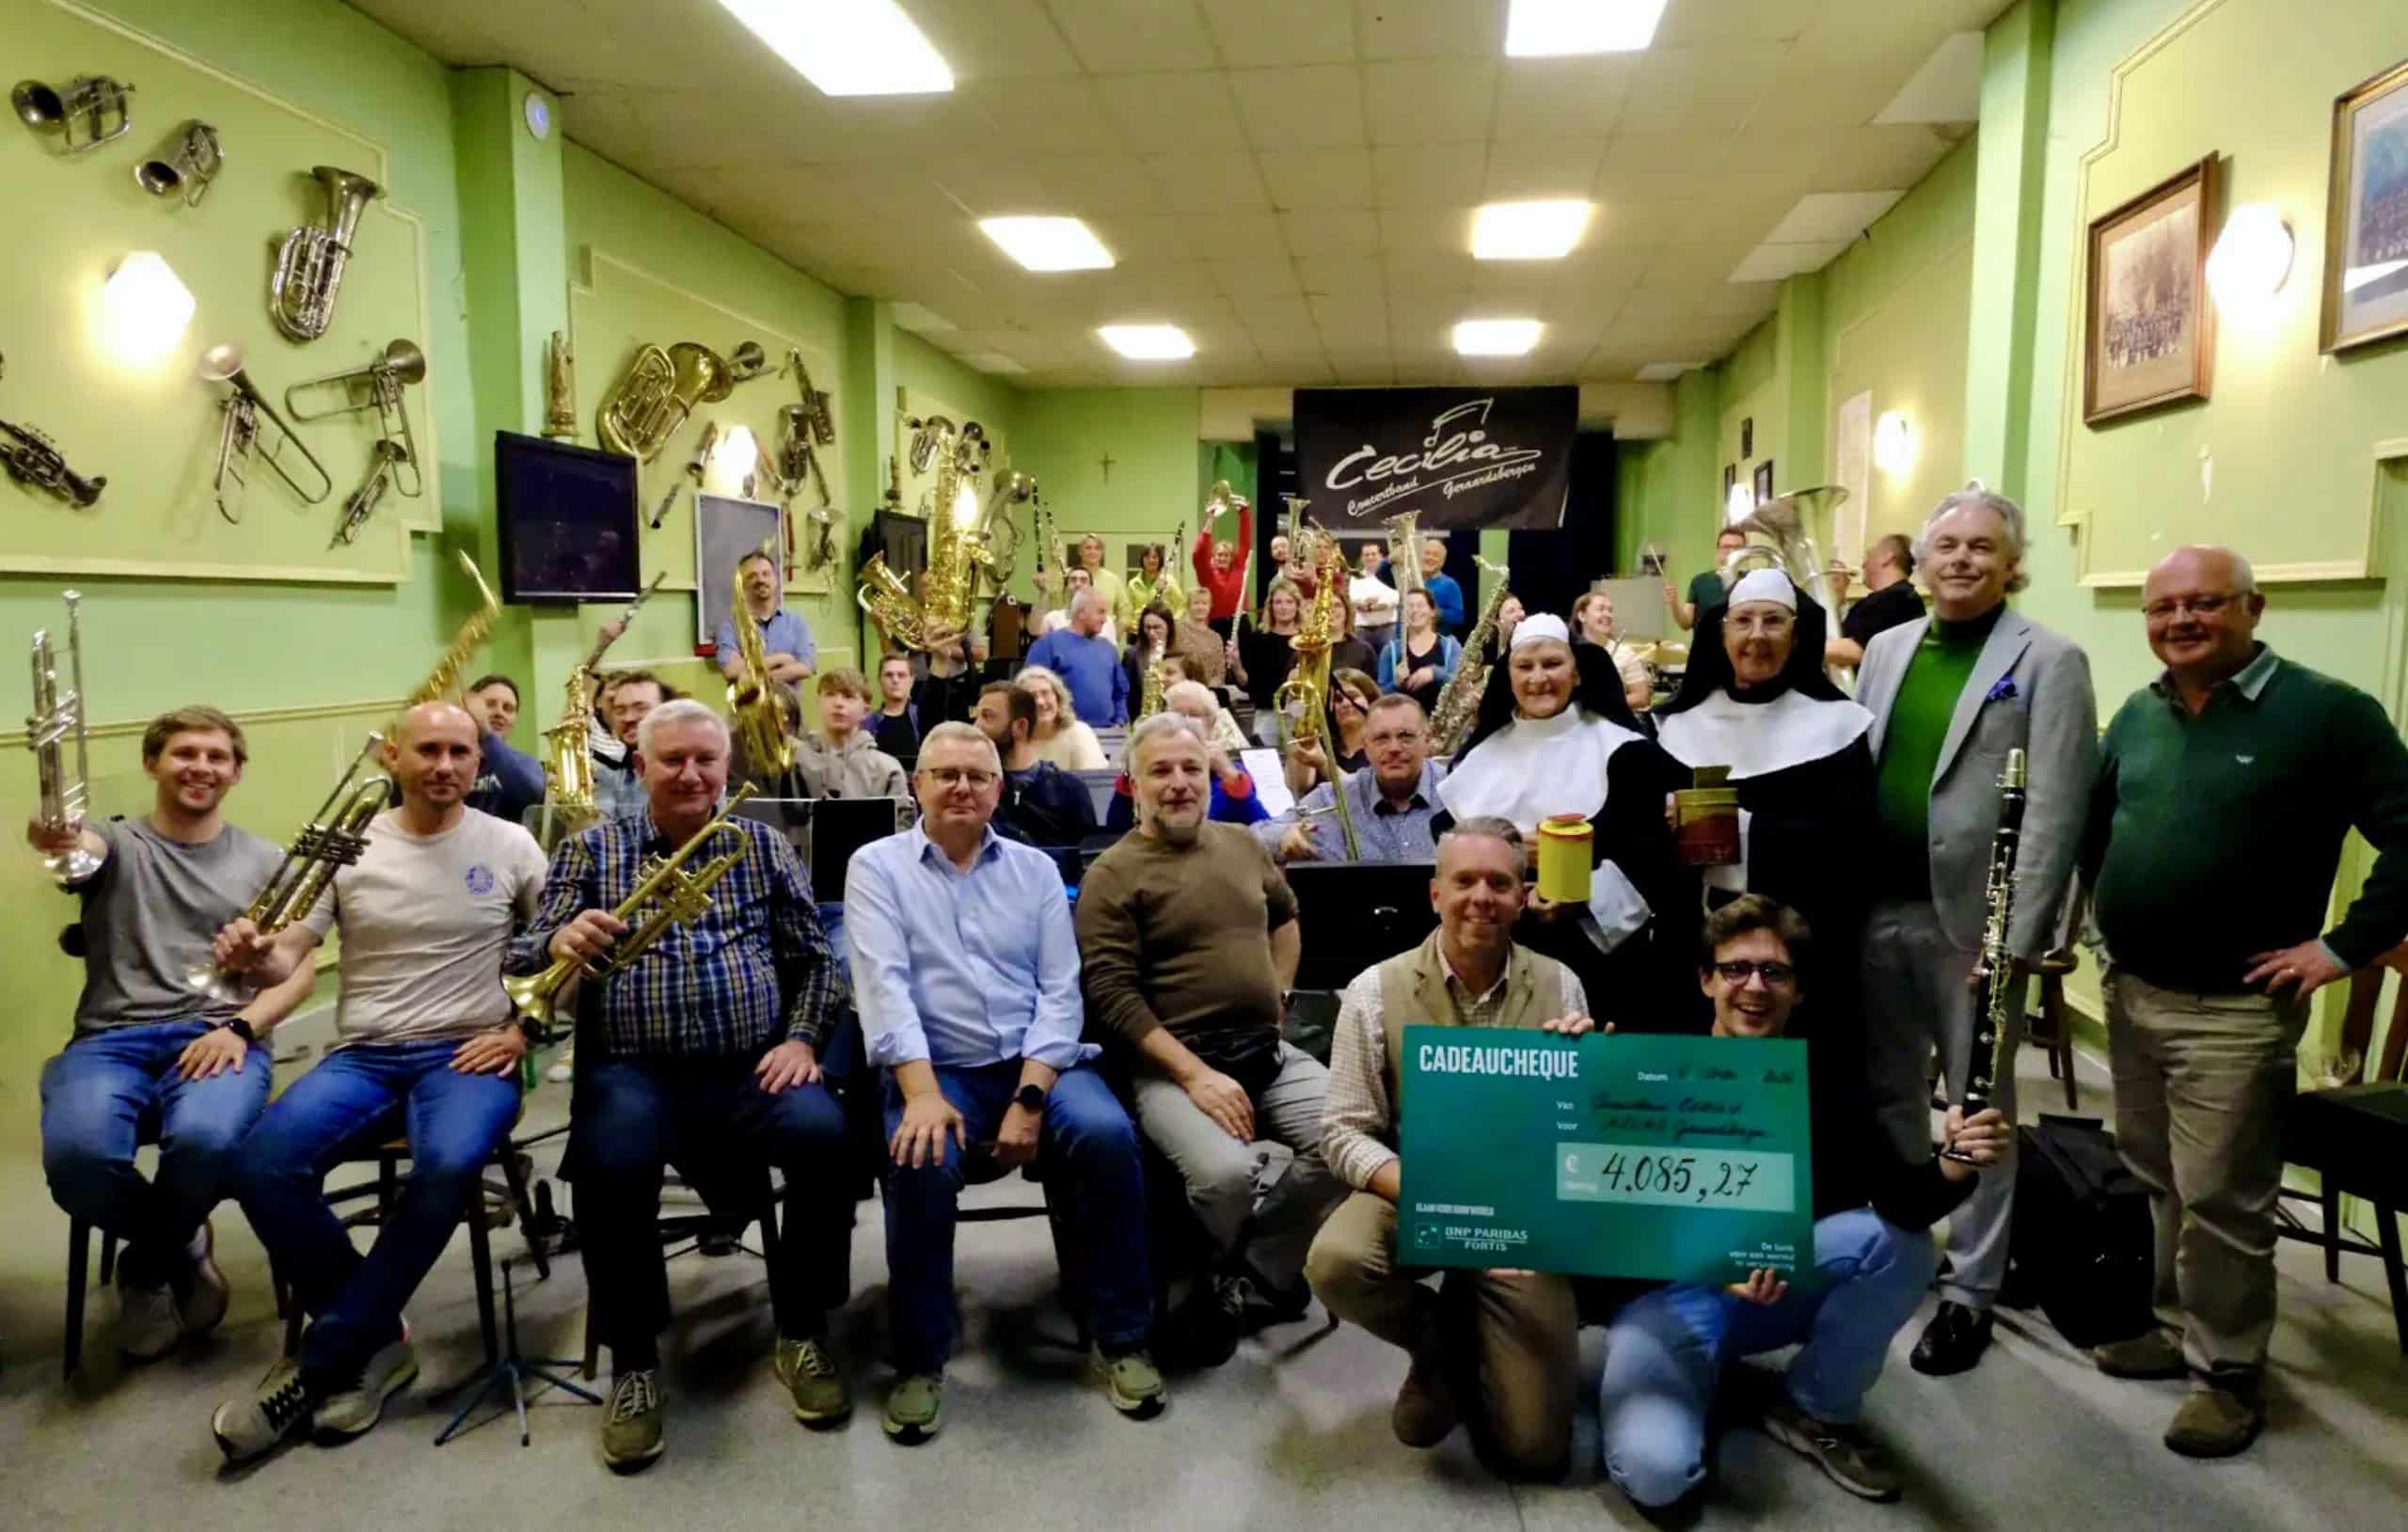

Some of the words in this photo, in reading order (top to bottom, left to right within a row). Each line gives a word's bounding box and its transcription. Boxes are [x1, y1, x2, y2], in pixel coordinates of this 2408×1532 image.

[1325, 429, 1542, 490] Cecilia
[1347, 476, 1419, 516] Concertband
[1443, 462, 1536, 499] Geraardsbergen
[1418, 1044, 1579, 1081] CADEAUCHEQUE
[1637, 1071, 1669, 1082] Datum
[1556, 1100, 1574, 1112] Van
[1602, 1152, 1758, 1203] 4.085,27
[1445, 1225, 1472, 1238] BNP
[1474, 1227, 1529, 1240] PARIBAS
[1464, 1240, 1508, 1252] FORTIS
